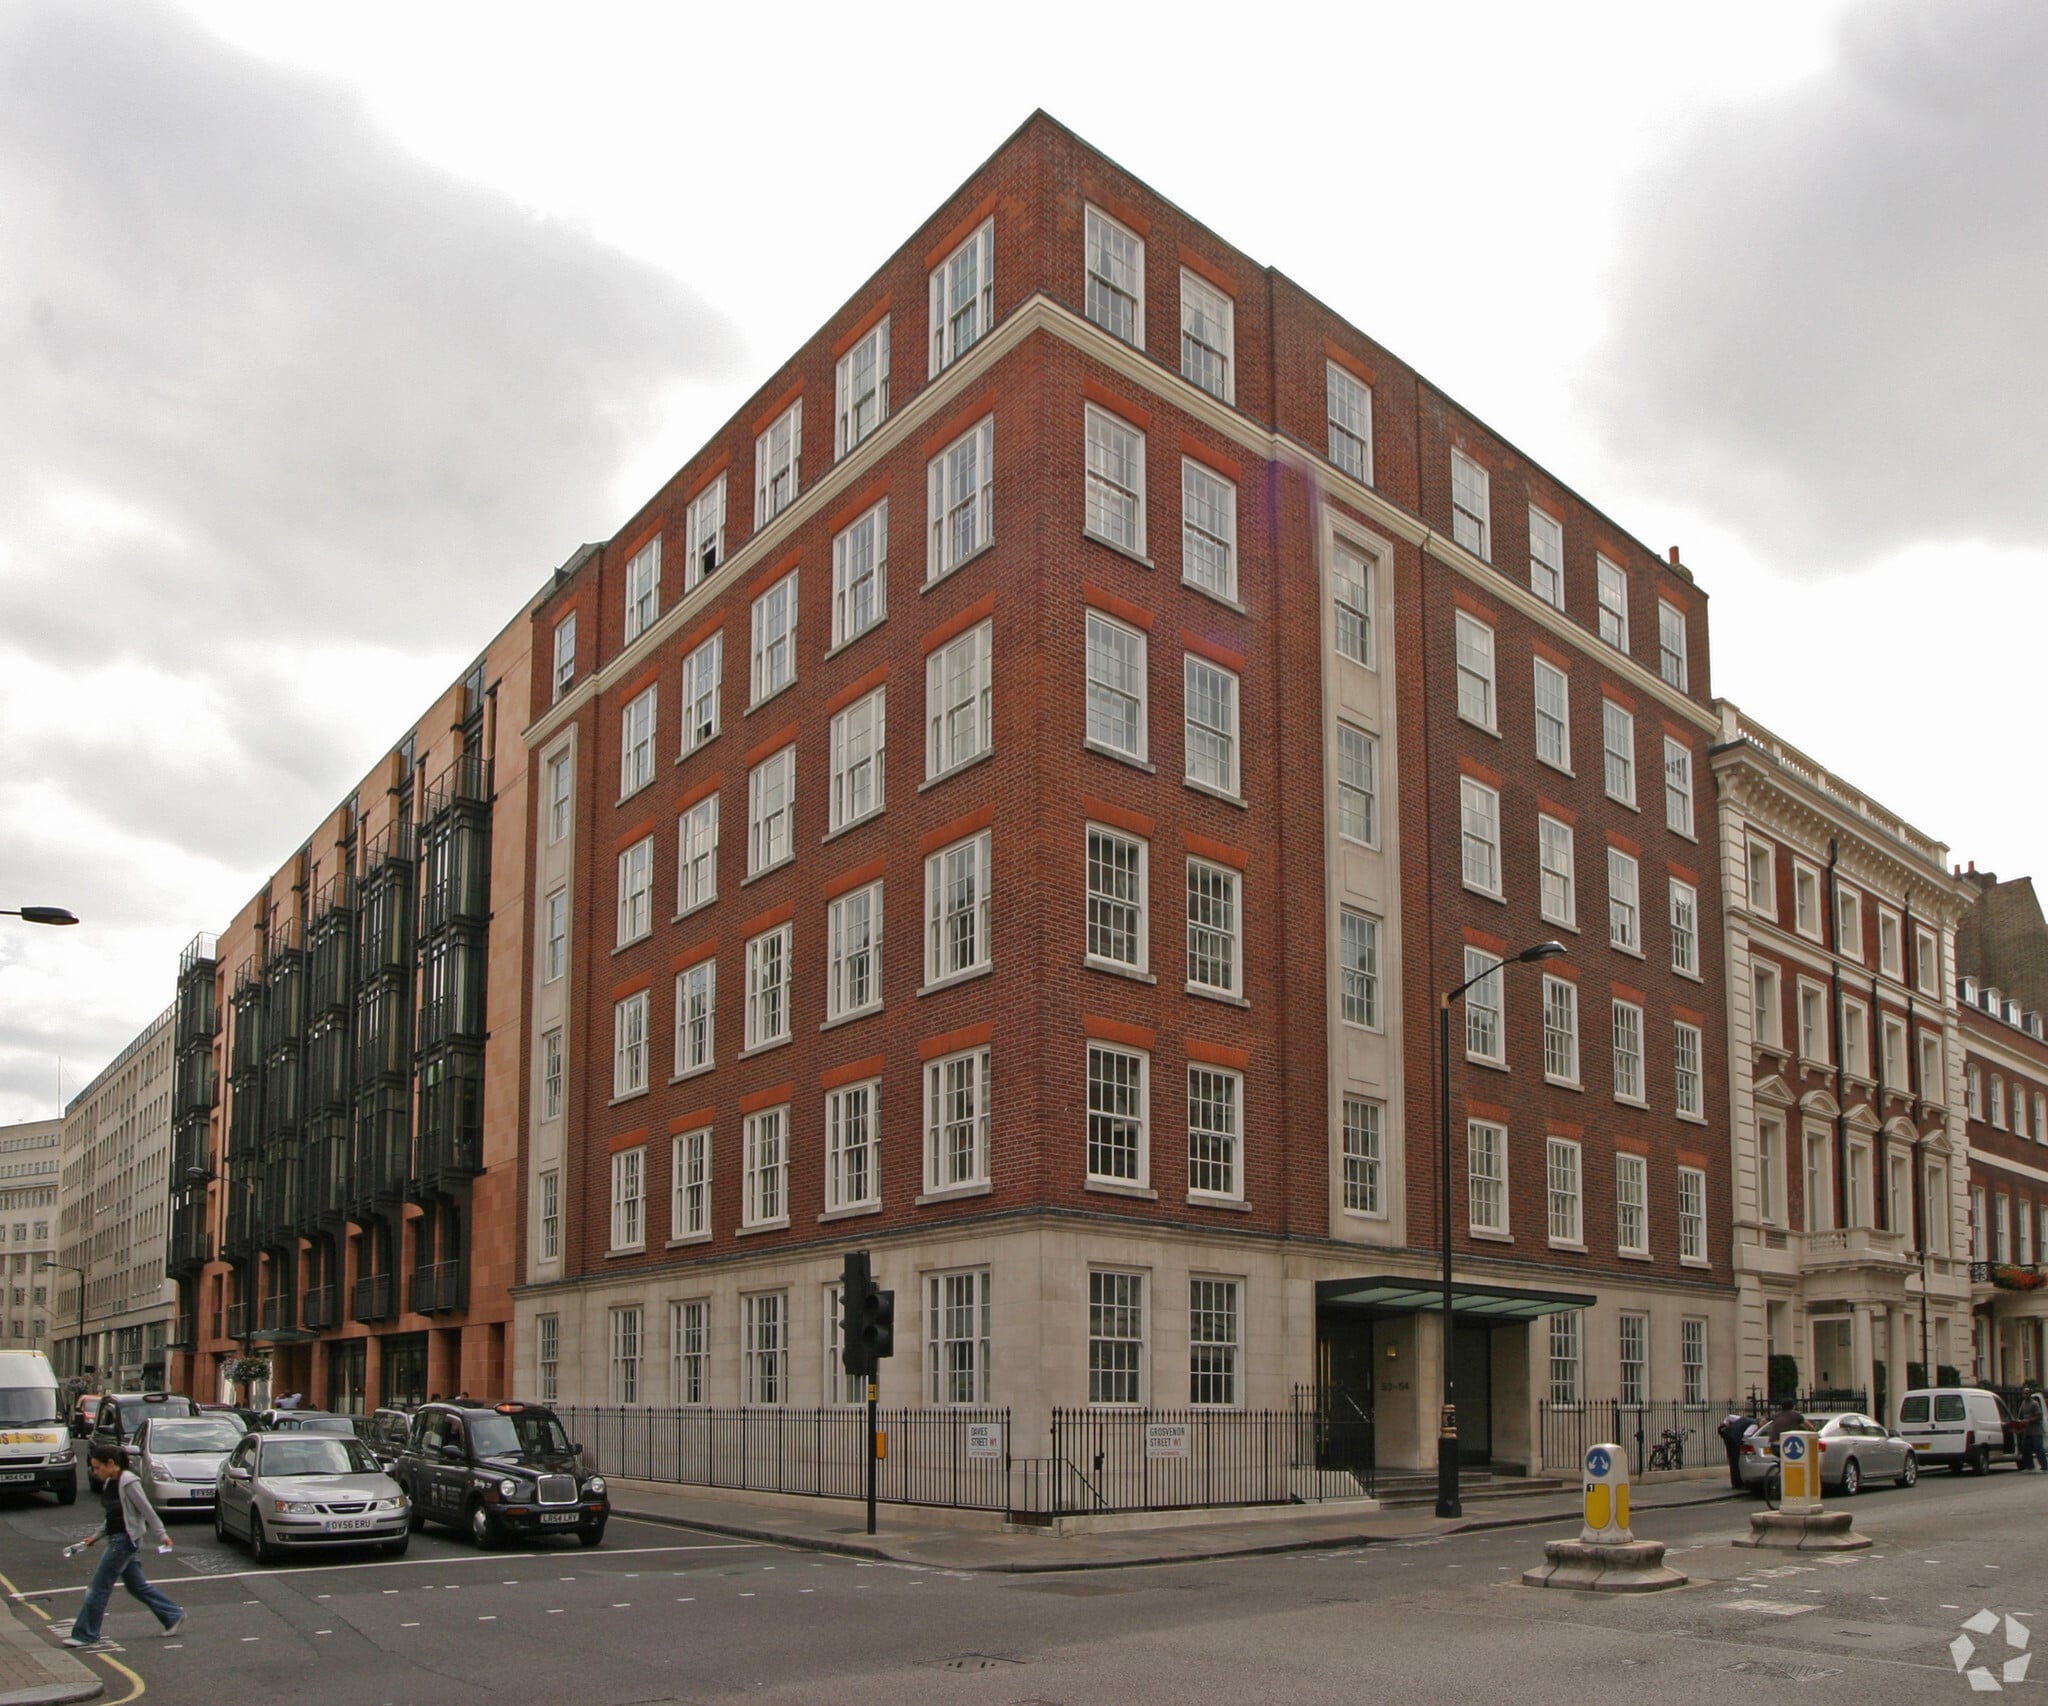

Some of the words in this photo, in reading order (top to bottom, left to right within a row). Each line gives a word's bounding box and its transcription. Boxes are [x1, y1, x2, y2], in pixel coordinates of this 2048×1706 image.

[1149, 1427, 1185, 1437] GROSVENOR
[970, 1437, 988, 1447] STREET
[1149, 1437, 1171, 1447] STREET
[1173, 1438, 1182, 1447] W1
[331, 1520, 354, 1530] OV56
[354, 1519, 371, 1529] ERU
